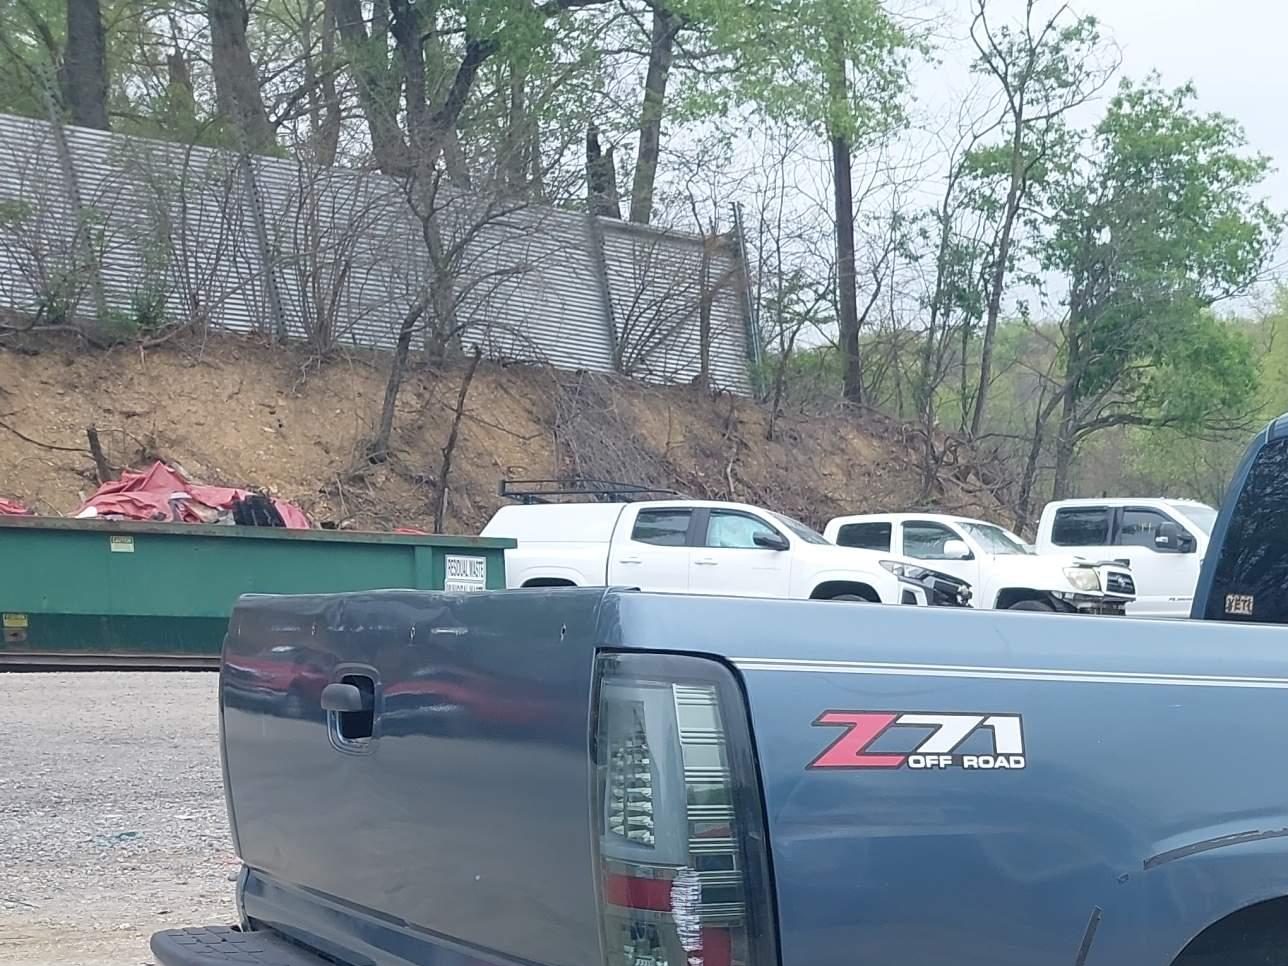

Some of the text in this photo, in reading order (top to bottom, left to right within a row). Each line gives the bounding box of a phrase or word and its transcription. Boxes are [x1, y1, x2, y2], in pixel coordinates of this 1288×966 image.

[1227, 597, 1252, 611] YETI
[806, 711, 1025, 769] Z71
[908, 755, 1026, 769] OFF ROAD
